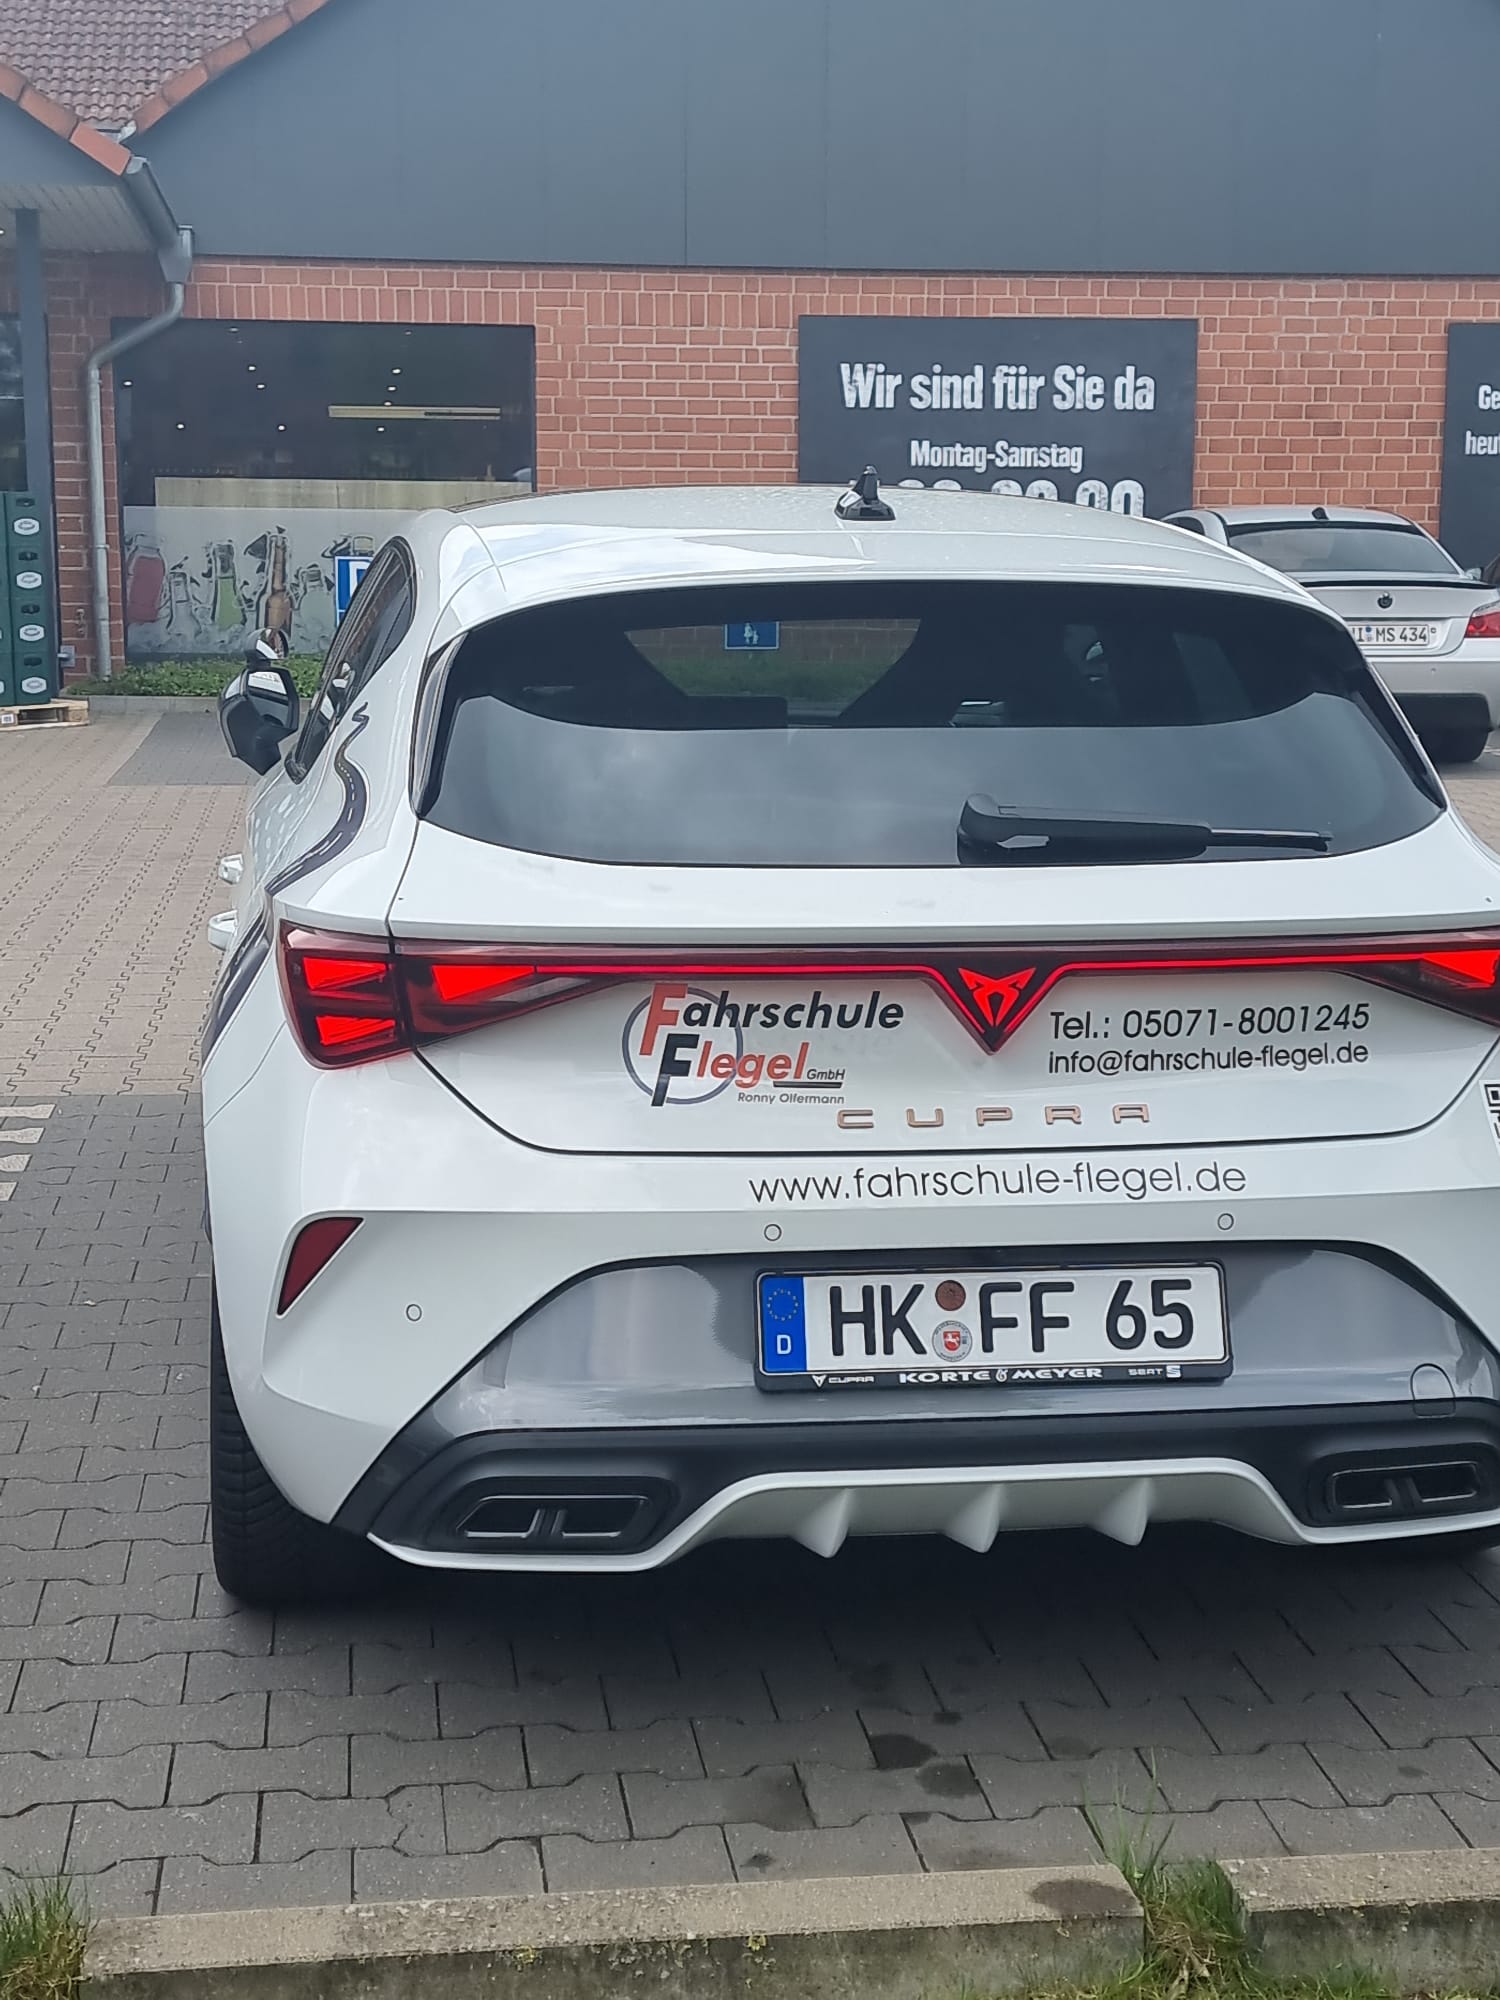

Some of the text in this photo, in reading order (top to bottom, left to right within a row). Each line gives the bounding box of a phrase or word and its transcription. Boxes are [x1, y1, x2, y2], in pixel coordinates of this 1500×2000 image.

[840, 363, 1156, 411] Wir sind für Sie da
[910, 440, 1084, 474] Montag-Samstag
[1465, 430, 1500, 455] heu
[1375, 627, 1396, 642] MS
[1399, 627, 1427, 642] 434
[639, 983, 904, 1056] Fahrschule
[1050, 1003, 1370, 1040] Tel.: 05071-8001245
[651, 1033, 810, 1107] Flegel
[806, 1068, 846, 1081] GmbH
[1048, 1041, 1369, 1076] info@fahrschule-flegel.de
[738, 1092, 776, 1105] Ronny
[837, 1103, 1151, 1130] CUPRA
[748, 1162, 1247, 1202] www.fahrschule-flegel.de
[776, 1334, 792, 1355] D
[829, 1284, 928, 1356] HK
[979, 1281, 1075, 1353] FF
[1105, 1279, 1194, 1350] 65
[828, 1375, 875, 1384] CUPRA
[899, 1370, 991, 1384] KORTE
[1011, 1367, 1103, 1380] MEYER
